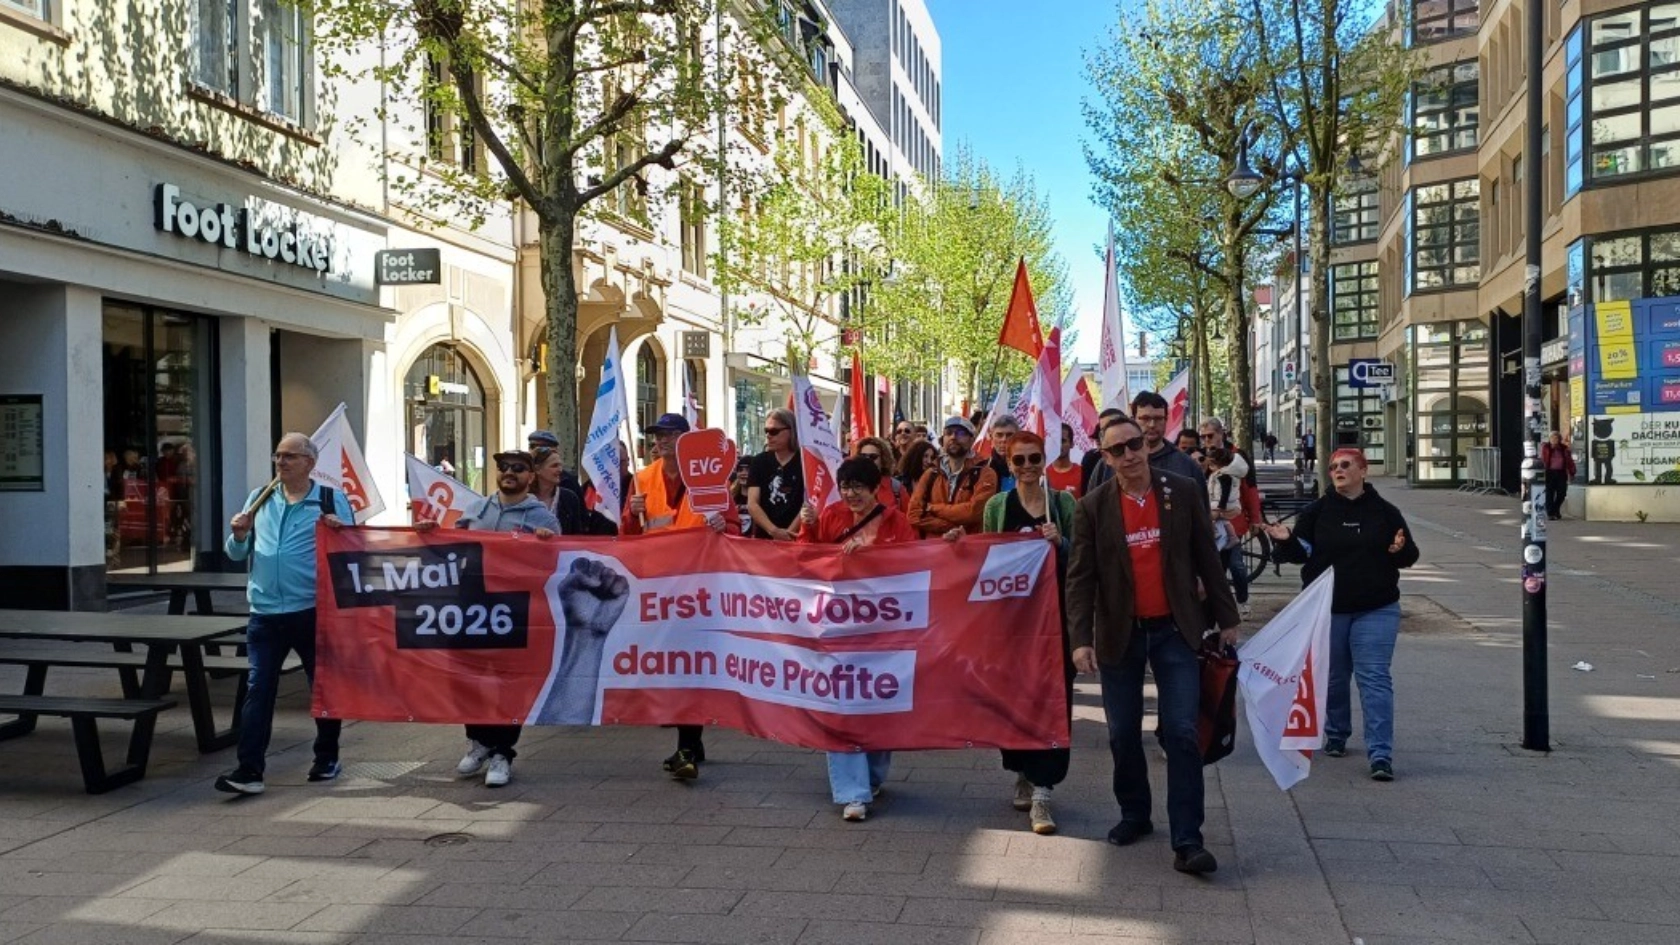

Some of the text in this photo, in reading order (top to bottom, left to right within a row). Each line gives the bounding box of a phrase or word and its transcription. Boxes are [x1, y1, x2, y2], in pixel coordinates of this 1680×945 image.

[157, 183, 236, 248] Foot
[382, 252, 416, 268] Foot
[382, 267, 434, 283] Locker
[1371, 366, 1390, 377] Tee
[1641, 420, 1661, 430] DER
[689, 457, 723, 476] EVG
[347, 563, 375, 593] 1.
[979, 574, 1030, 597] DGB
[640, 588, 914, 624] Erst unsere Jobs,
[415, 603, 514, 636] 2026
[613, 645, 899, 700] dann eure Profite
